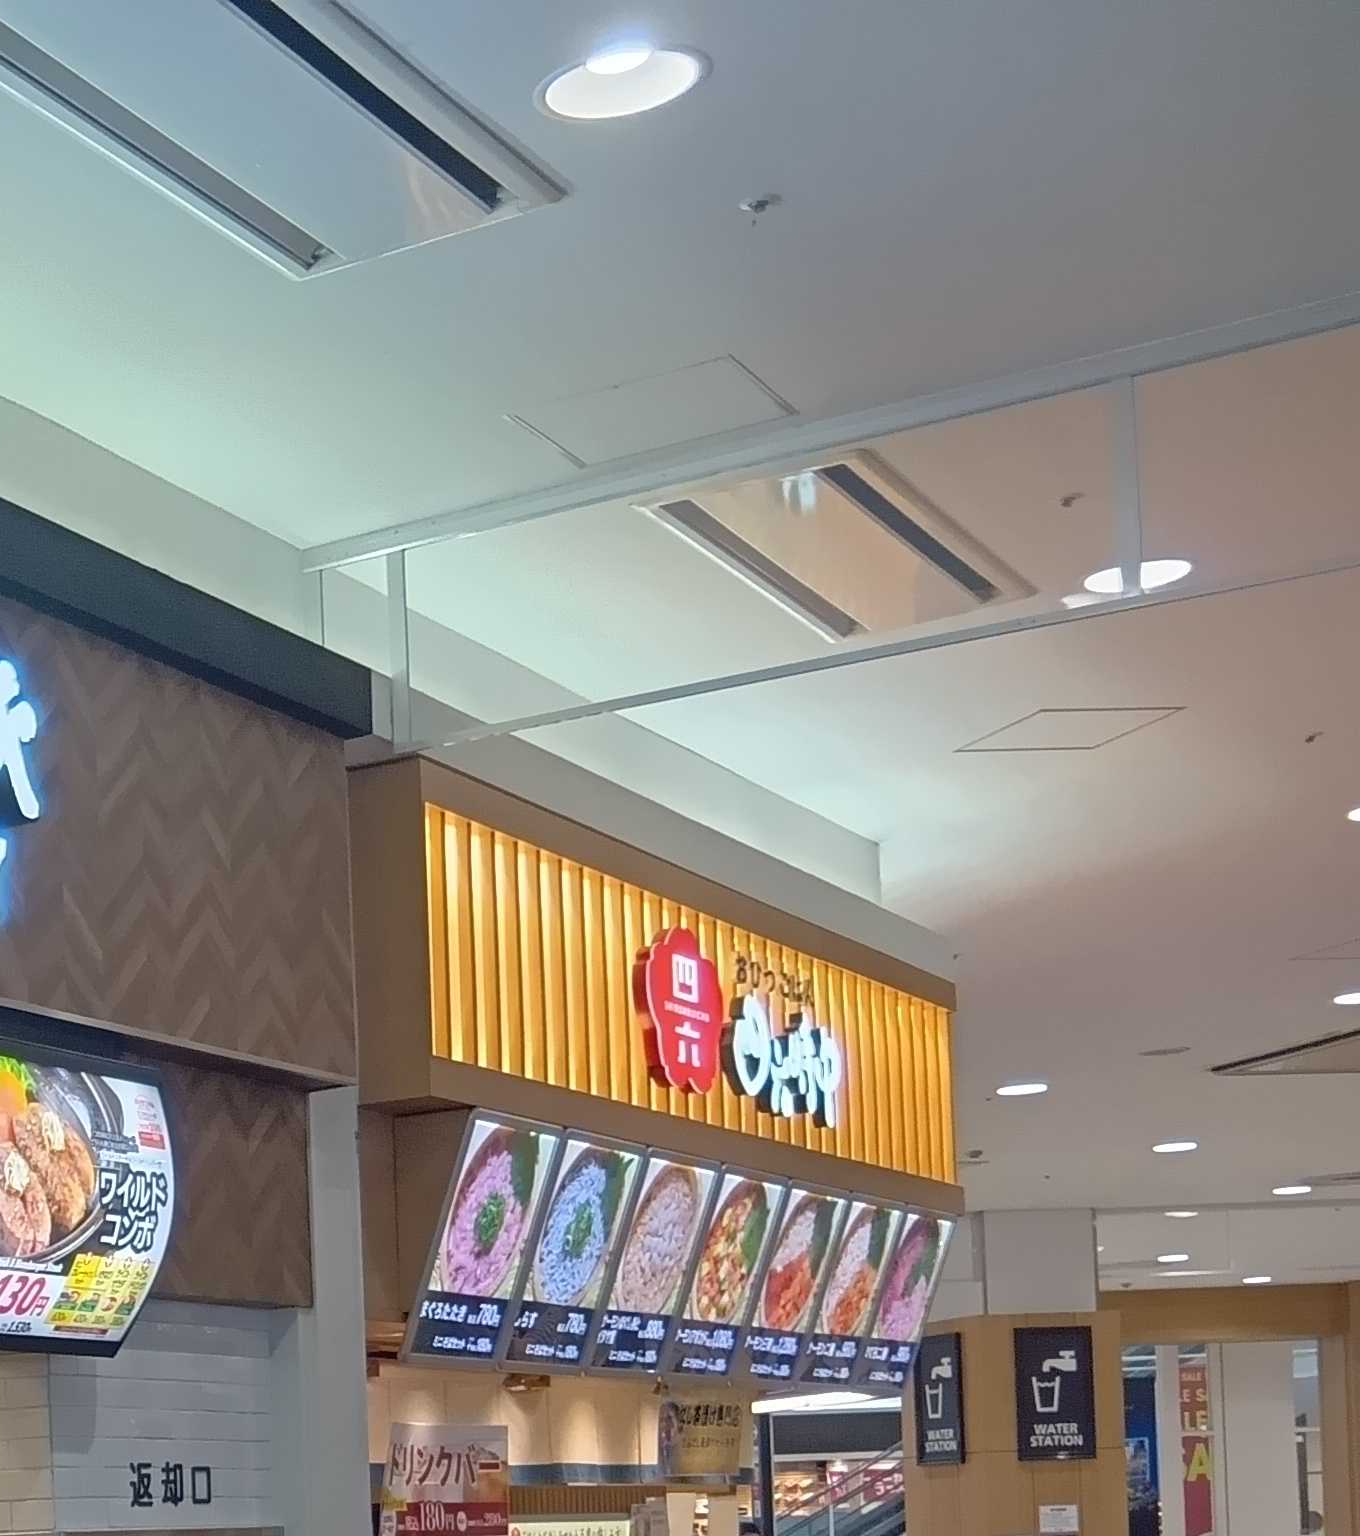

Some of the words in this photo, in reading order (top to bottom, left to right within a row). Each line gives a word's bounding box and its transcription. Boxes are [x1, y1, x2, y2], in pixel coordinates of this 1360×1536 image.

[99, 1171, 167, 1210] ワイルド
[99, 1212, 156, 1251] コンボ
[926, 1428, 955, 1441] WATER
[1030, 1434, 1084, 1448] STATION
[1033, 1422, 1079, 1435] WATER
[924, 1440, 958, 1453] STATION
[388, 1443, 500, 1487] ドリンクバー
[129, 1461, 212, 1507] 返却口
